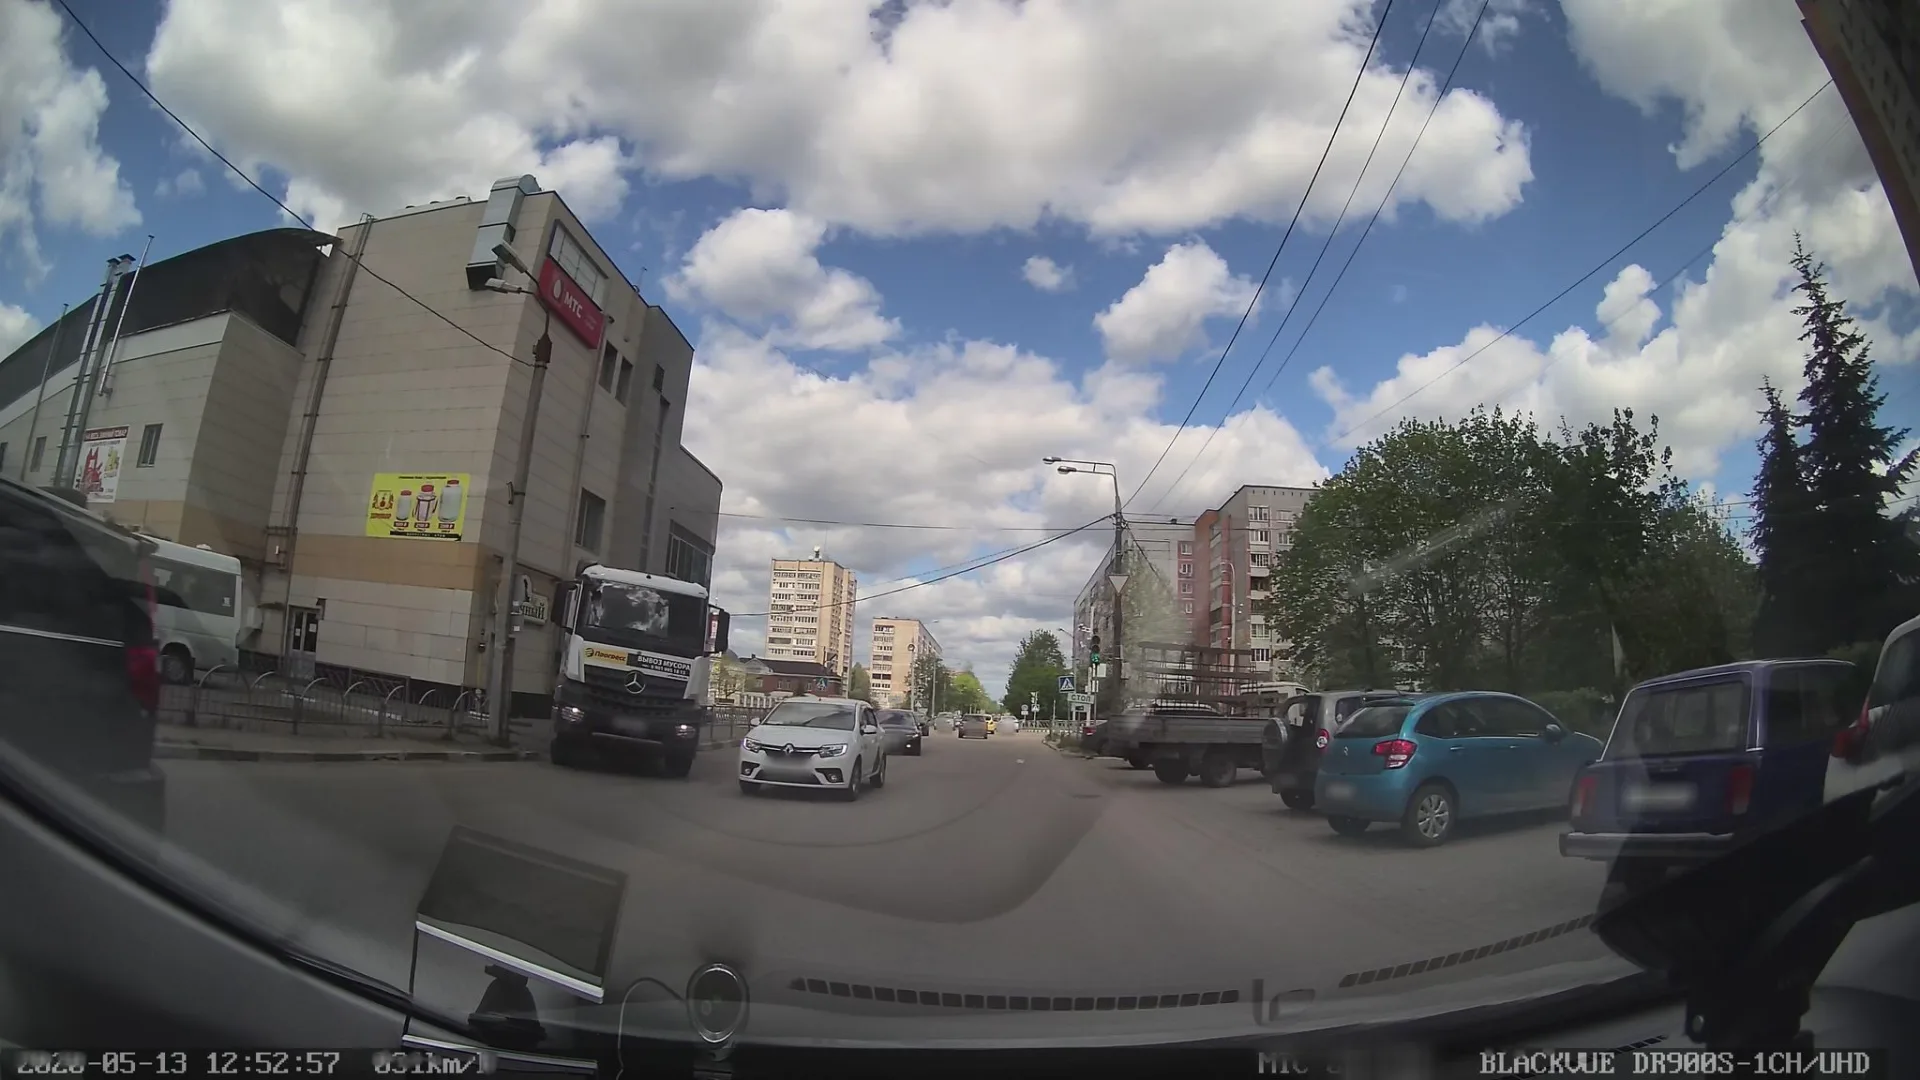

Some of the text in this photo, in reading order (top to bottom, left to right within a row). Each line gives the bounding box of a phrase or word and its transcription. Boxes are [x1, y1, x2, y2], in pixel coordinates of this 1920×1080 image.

[563, 291, 583, 319] МТС
[637, 655, 691, 670] ВЫВОЗ МУСОРА
